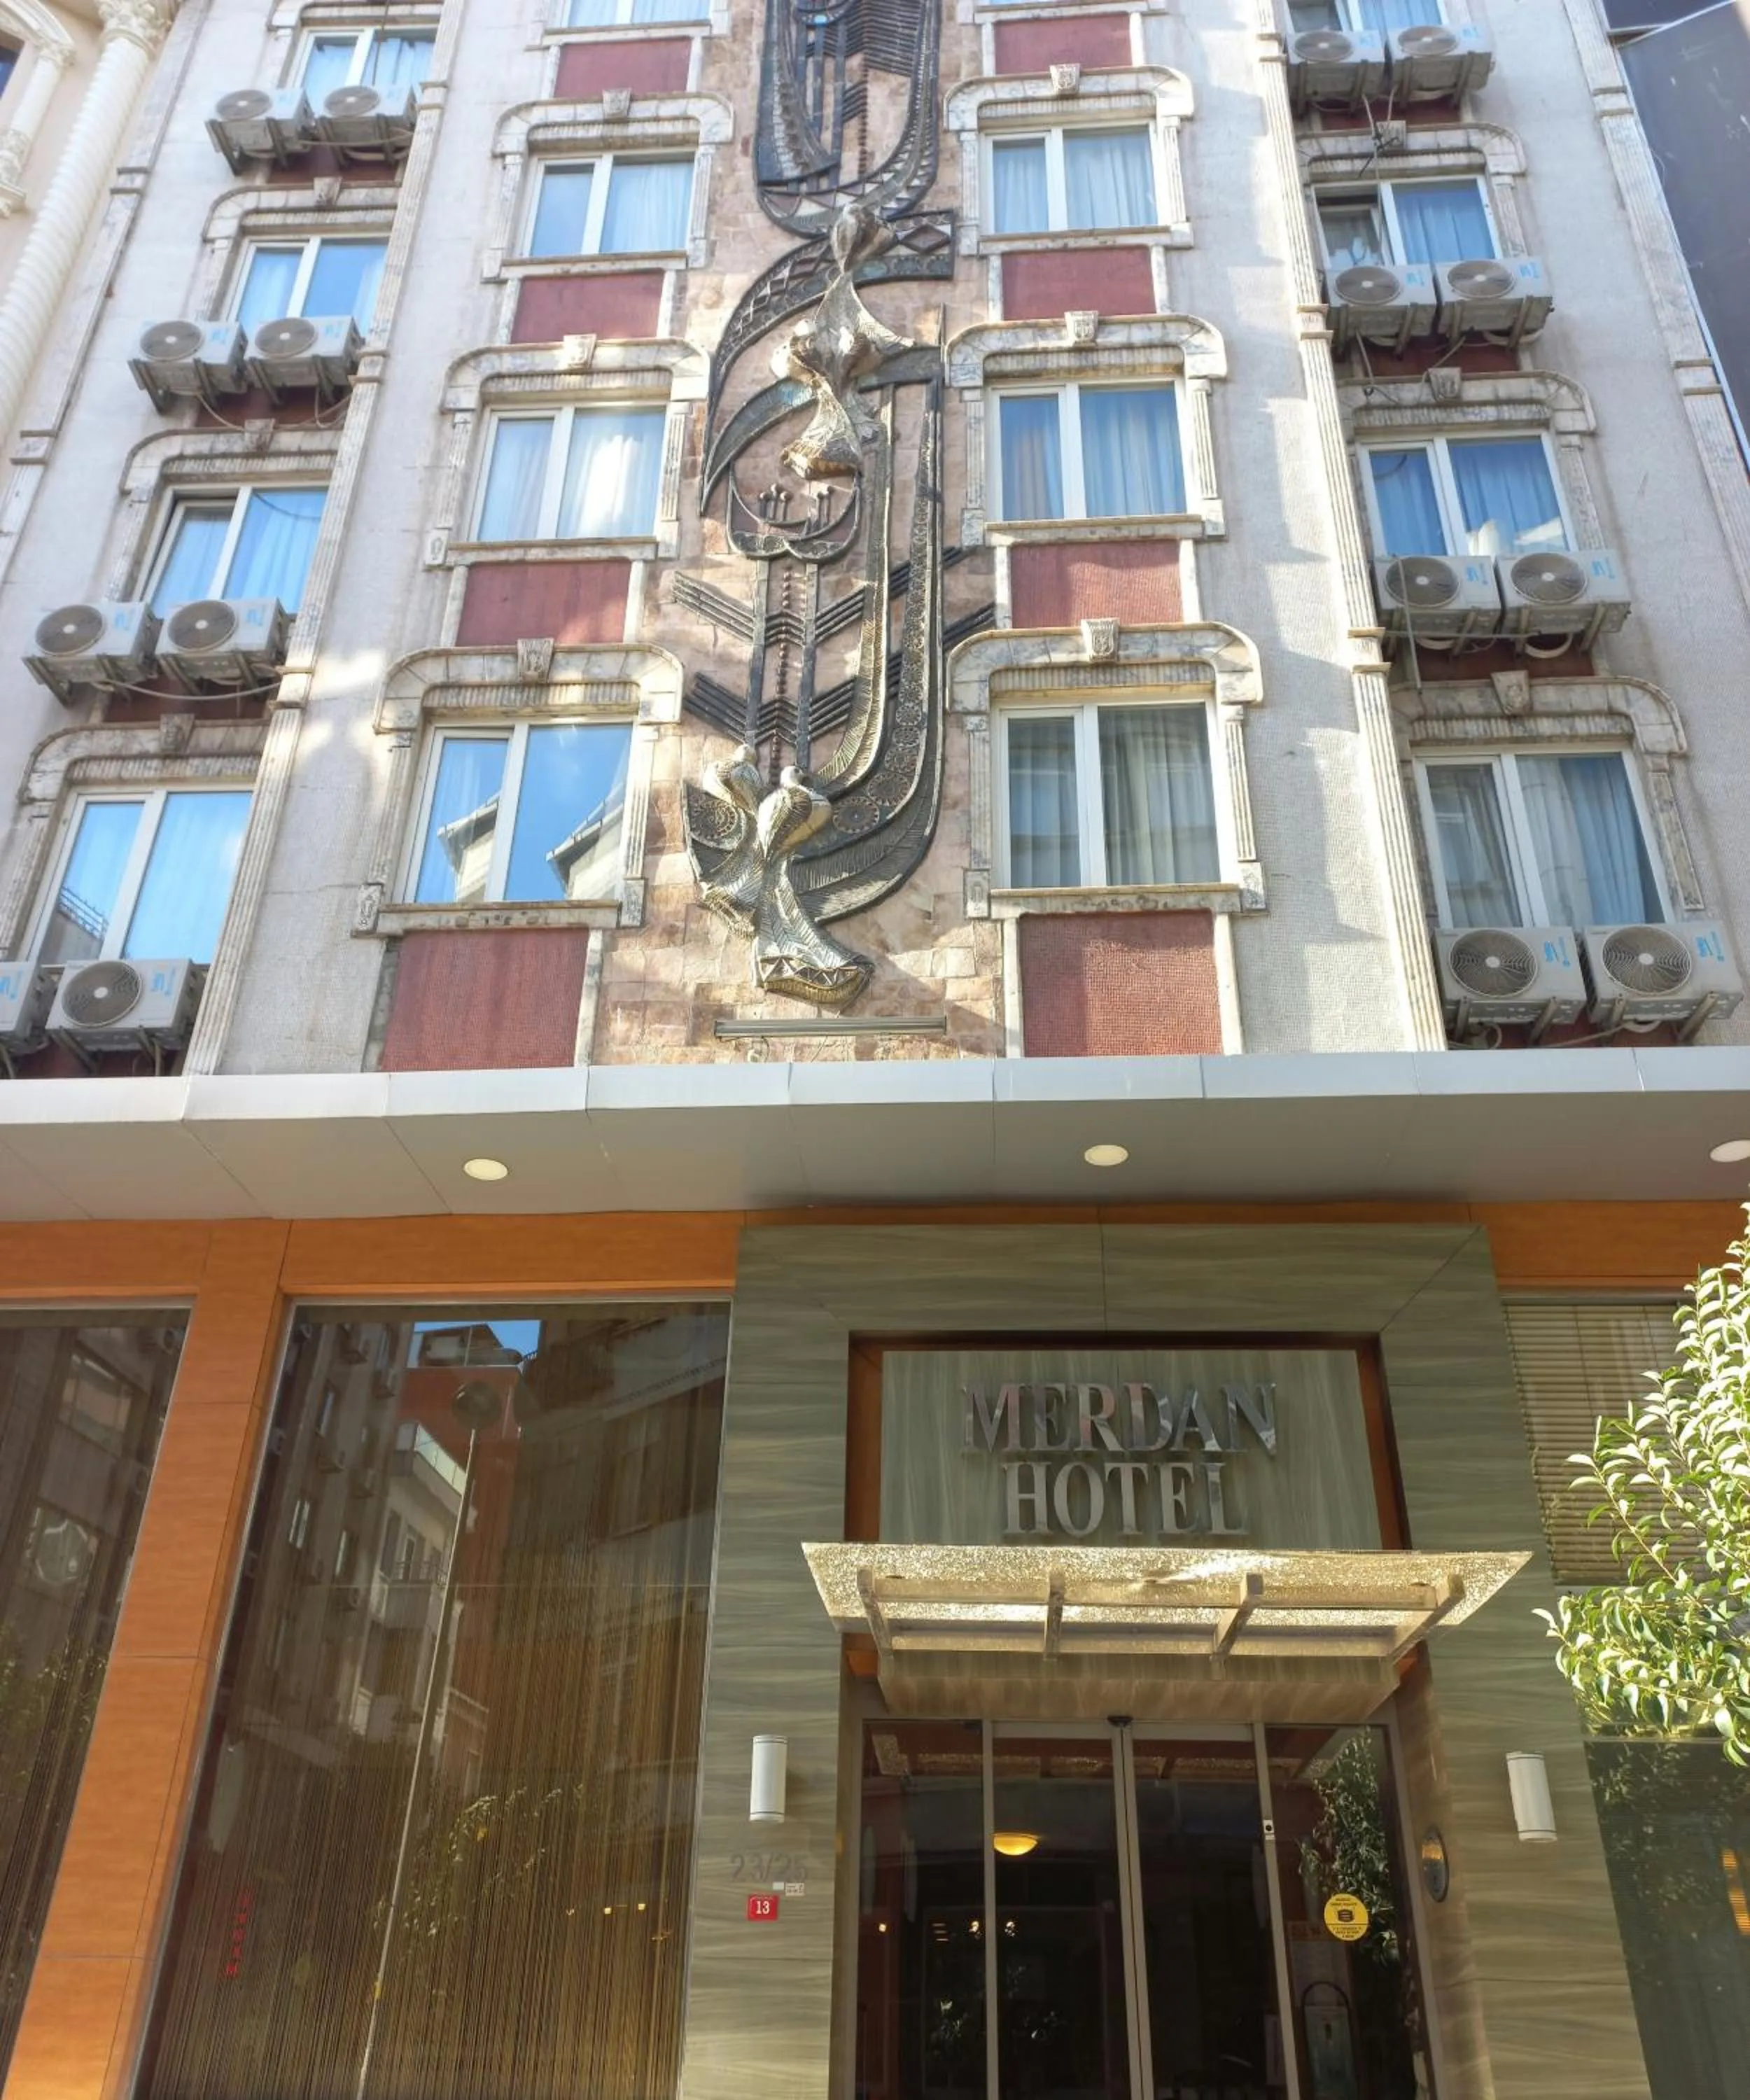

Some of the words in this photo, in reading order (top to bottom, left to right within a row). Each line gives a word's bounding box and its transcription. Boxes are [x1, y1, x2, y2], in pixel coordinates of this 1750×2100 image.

[962, 1382, 1278, 1456] MERDAN
[1002, 1461, 1249, 1537] HOTEL
[756, 1900, 770, 1914] 13
